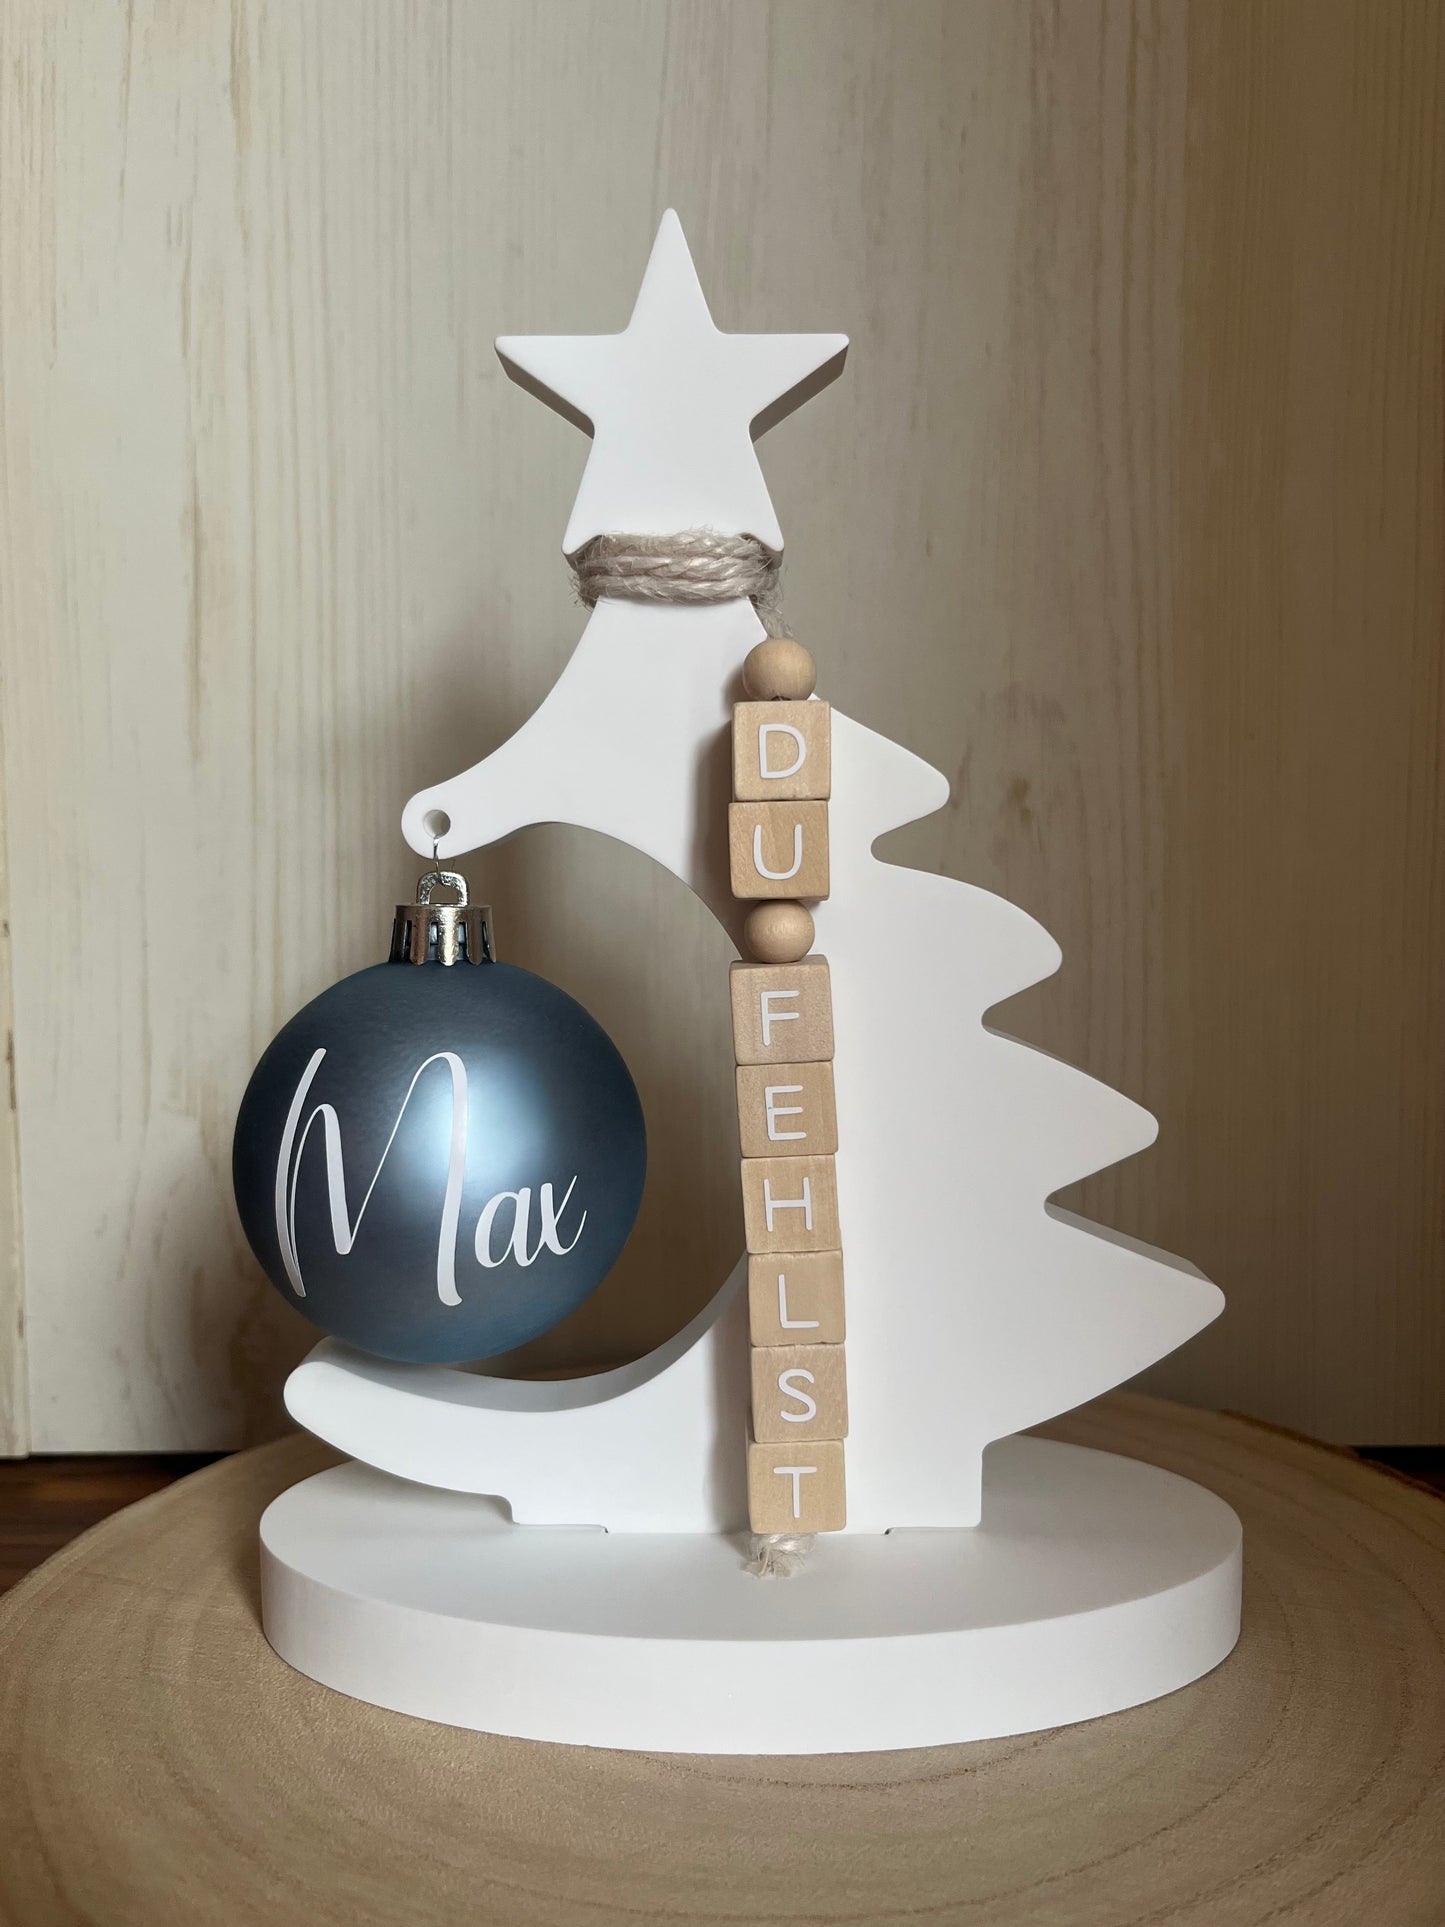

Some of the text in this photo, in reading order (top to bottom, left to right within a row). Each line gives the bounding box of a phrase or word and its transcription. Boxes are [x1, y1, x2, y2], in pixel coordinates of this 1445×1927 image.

[275, 1047, 588, 1306] Max
[754, 723, 820, 1519] DU FEHLST
